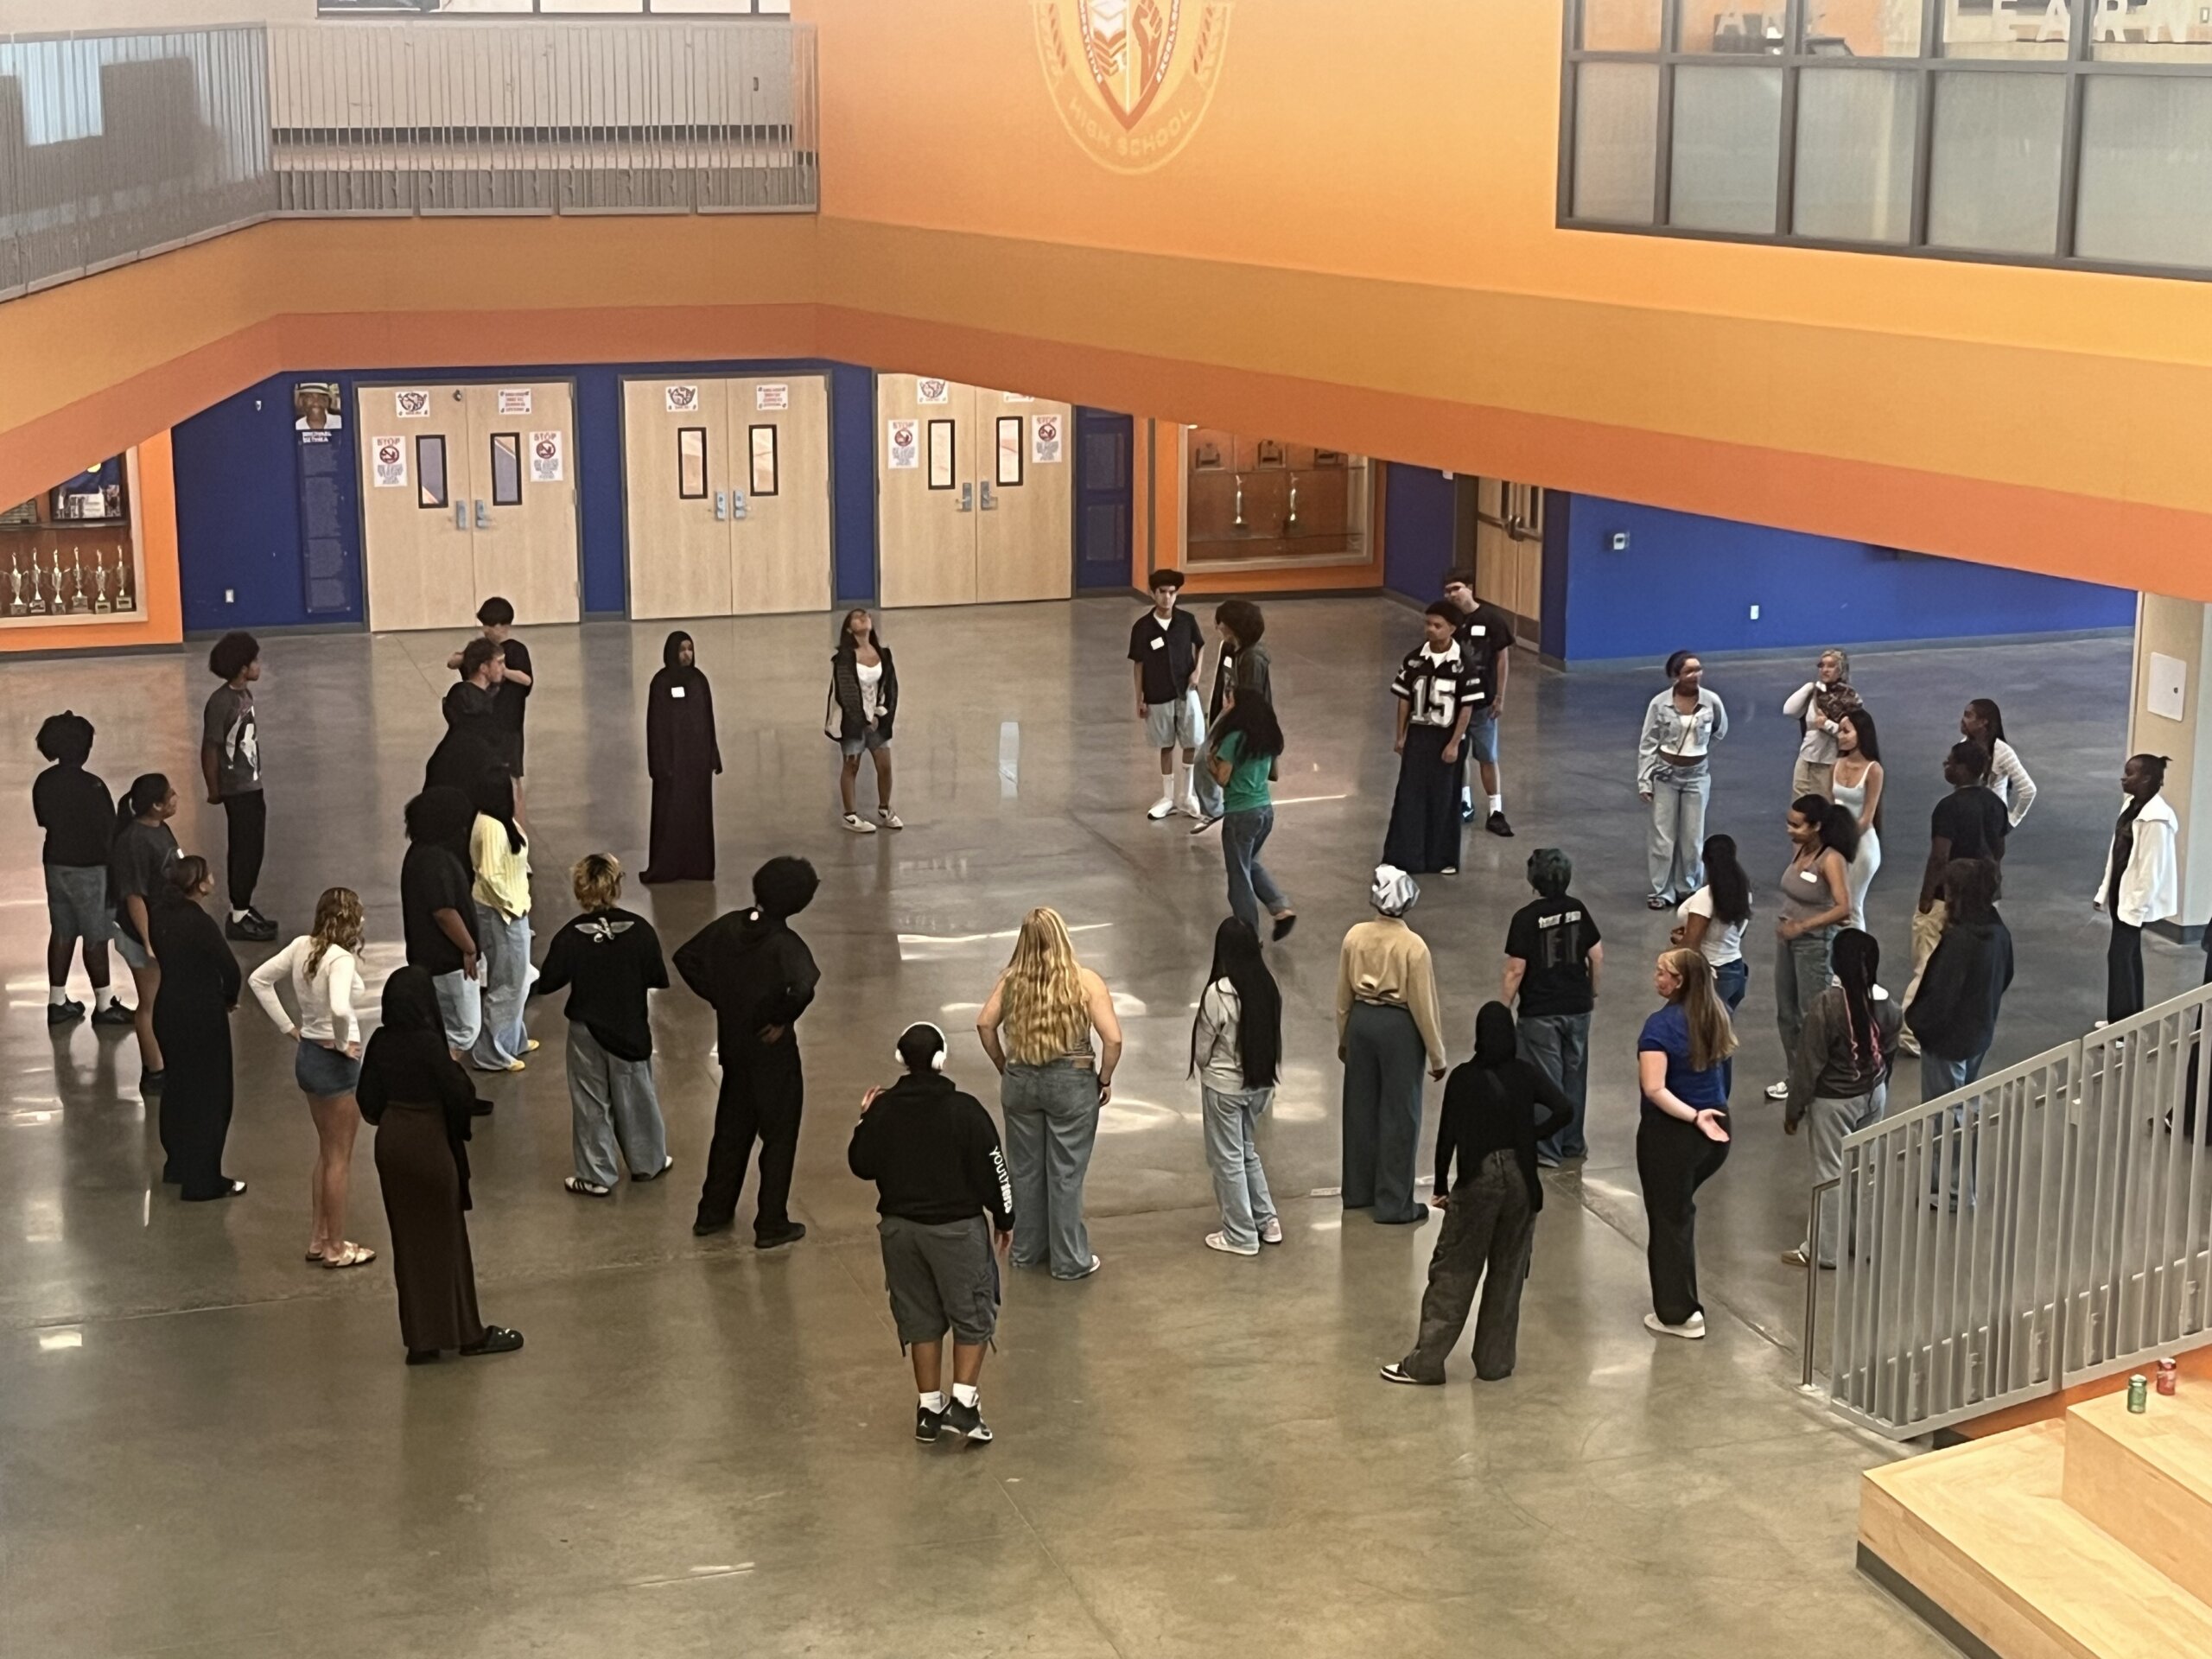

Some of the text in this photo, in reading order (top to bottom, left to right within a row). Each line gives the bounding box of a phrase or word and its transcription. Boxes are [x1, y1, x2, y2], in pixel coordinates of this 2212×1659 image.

[1069, 97, 1192, 156] HIGH SCHOOL
[1410, 675, 1457, 728] 15
